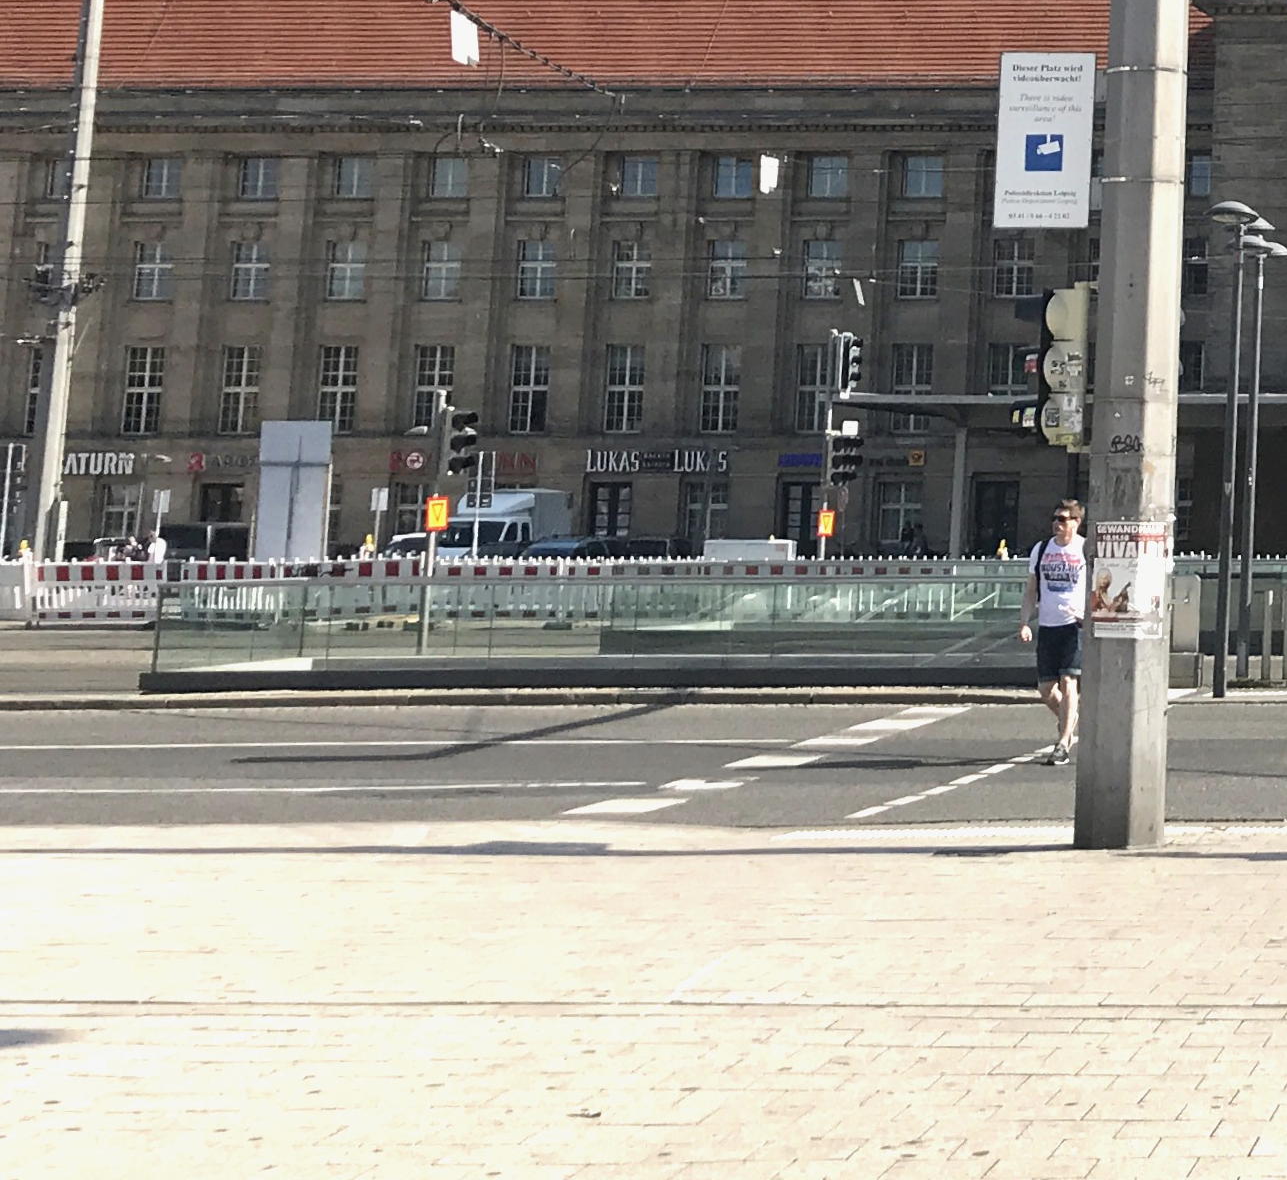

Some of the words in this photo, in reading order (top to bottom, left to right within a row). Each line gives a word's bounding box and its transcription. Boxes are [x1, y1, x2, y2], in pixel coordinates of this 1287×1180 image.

[1012, 64, 1038, 72] Dieser
[1064, 64, 1083, 72] wird
[63, 452, 135, 475] ATURN
[586, 449, 640, 472] LUKAS
